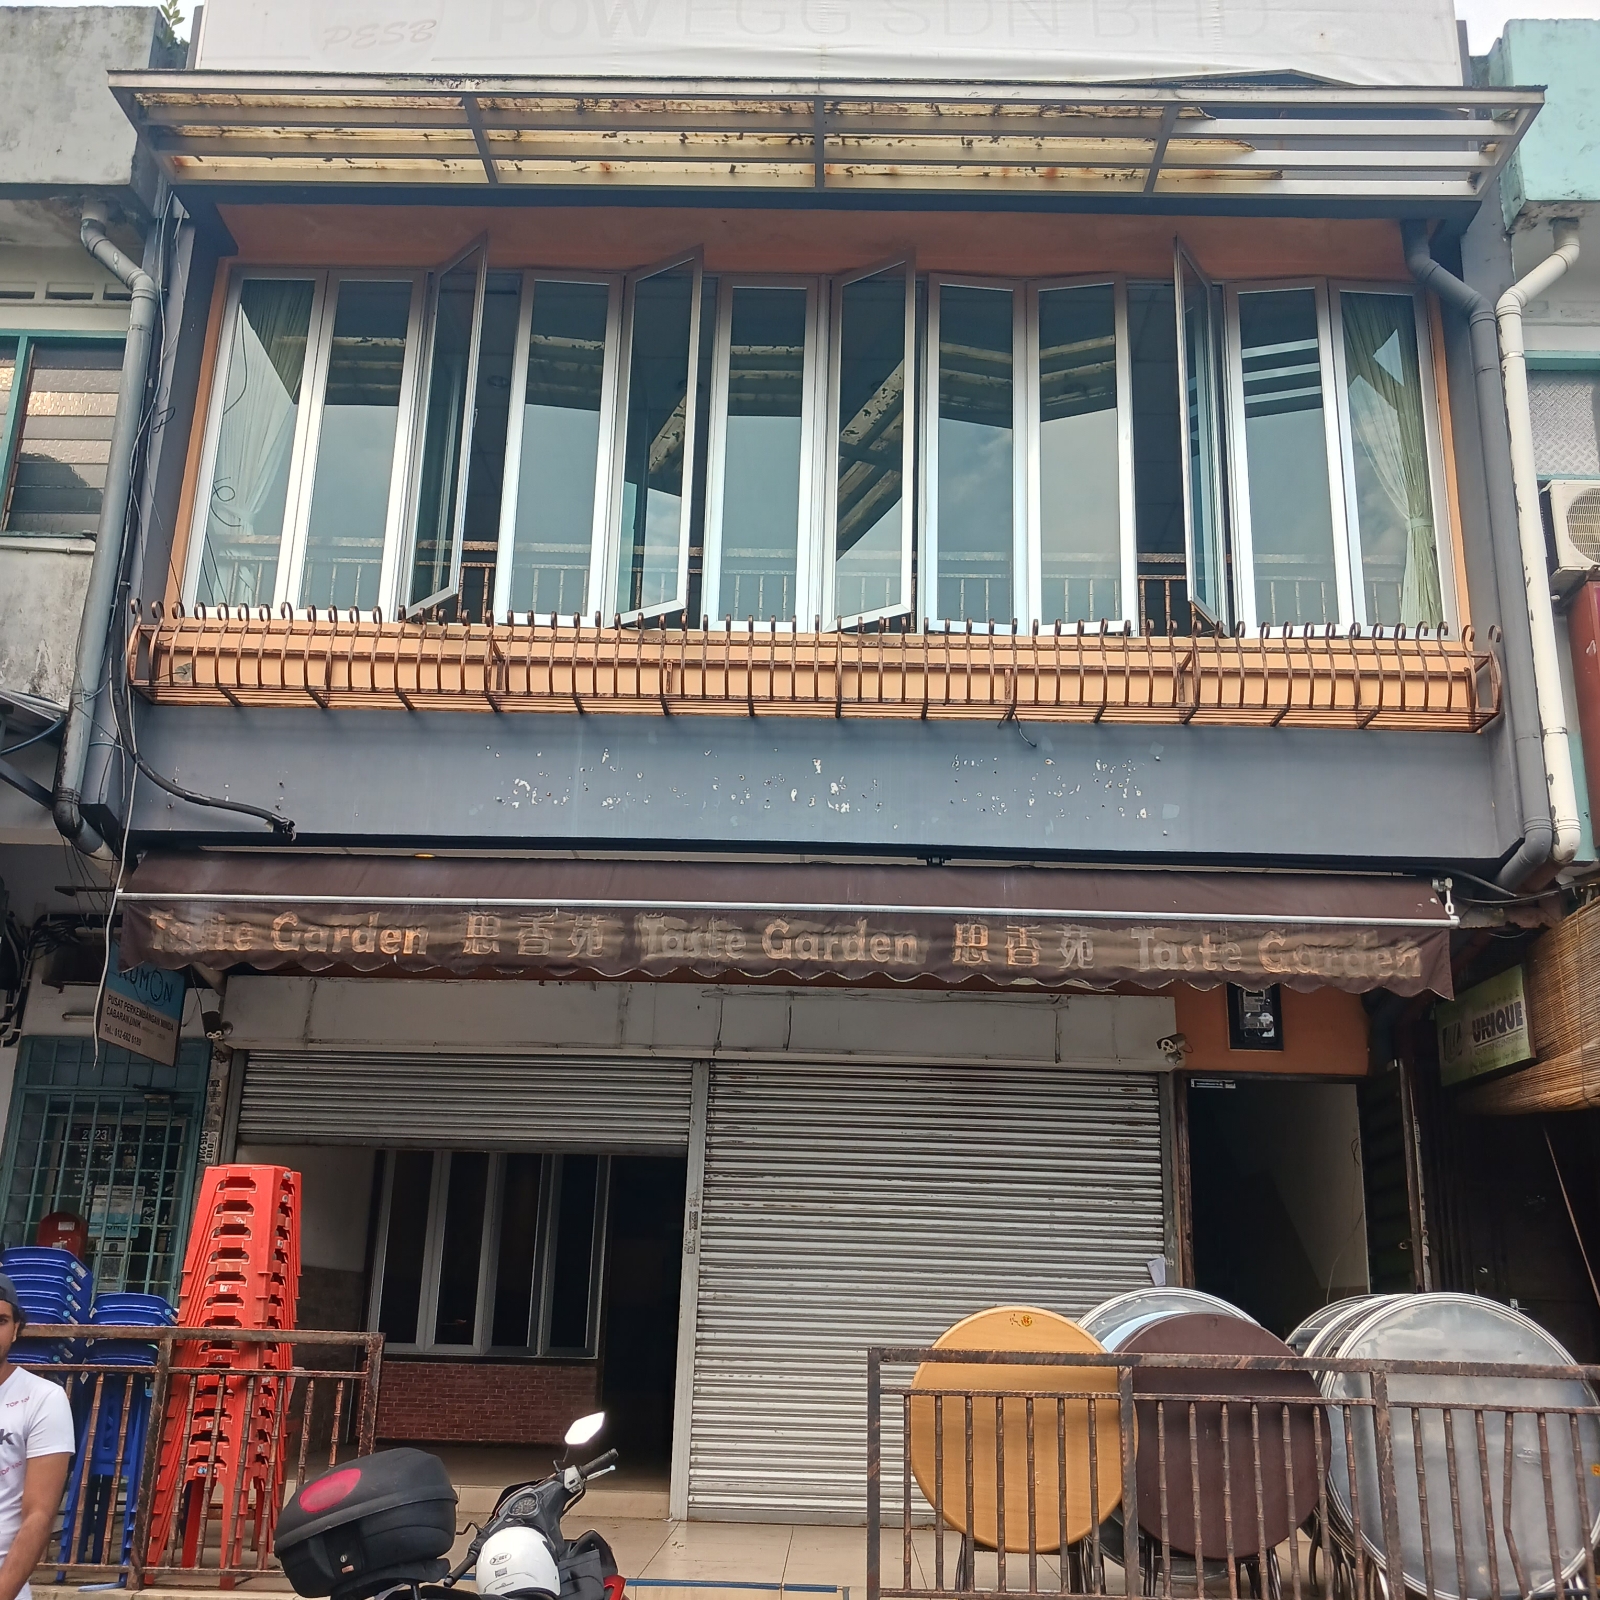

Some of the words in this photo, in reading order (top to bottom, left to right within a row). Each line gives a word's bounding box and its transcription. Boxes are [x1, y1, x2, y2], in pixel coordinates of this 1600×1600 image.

[322, 18, 439, 51] PESB
[882, 0, 1060, 38] SDN
[271, 910, 430, 955] Garden
[762, 917, 920, 962] Garden
[953, 922, 1095, 969] 思香苑
[1130, 926, 1242, 973] Taste
[1258, 929, 1422, 978] Garden
[108, 994, 124, 1010] PUSAT
[1471, 1001, 1524, 1043] UNIQUE
